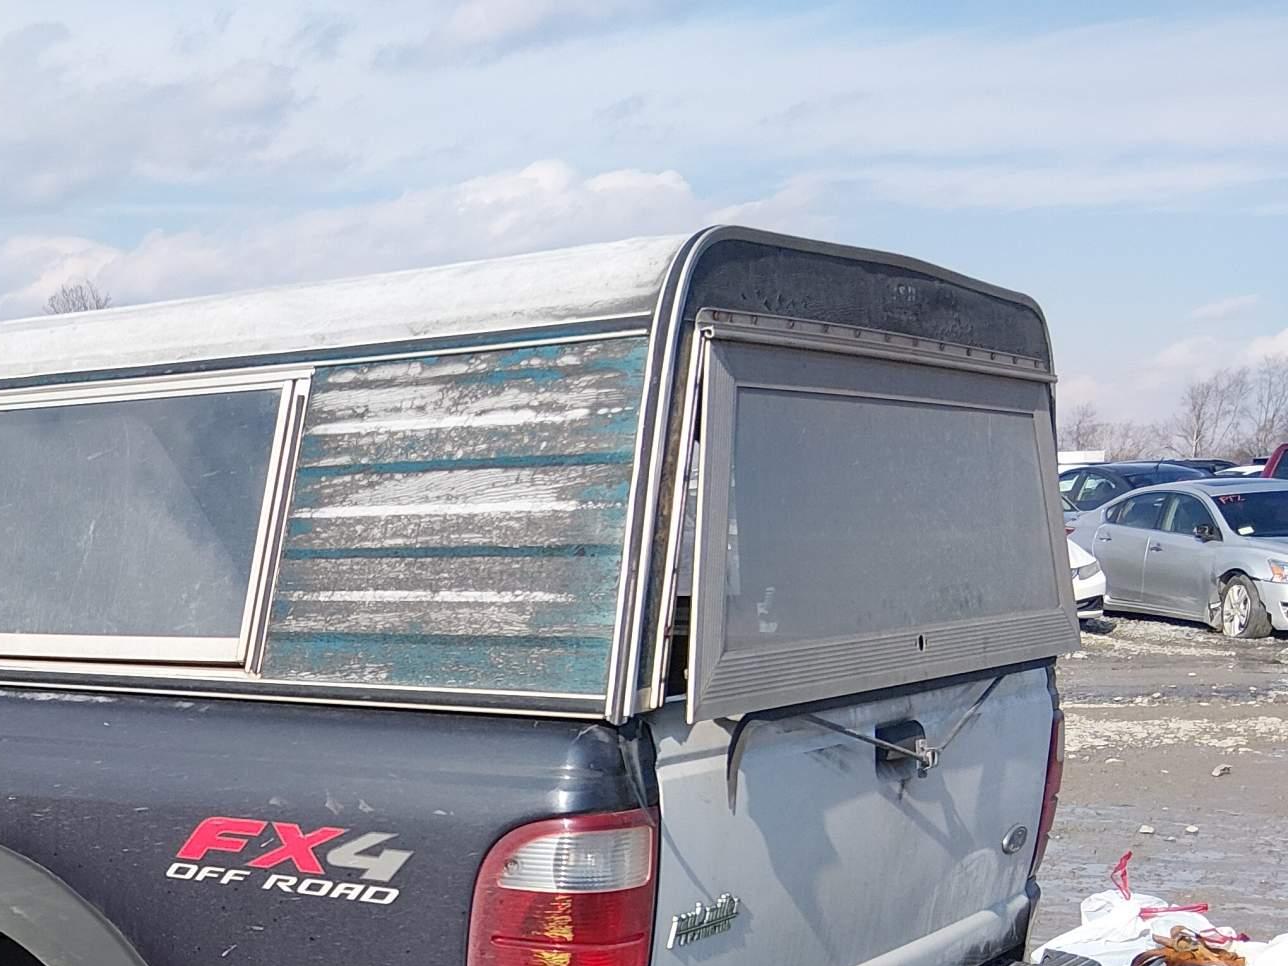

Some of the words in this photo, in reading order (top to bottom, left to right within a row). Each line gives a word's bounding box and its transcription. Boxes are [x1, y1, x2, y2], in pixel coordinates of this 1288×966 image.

[175, 816, 415, 882] FX4
[165, 862, 252, 885] OFF
[261, 874, 401, 906] ROAD
